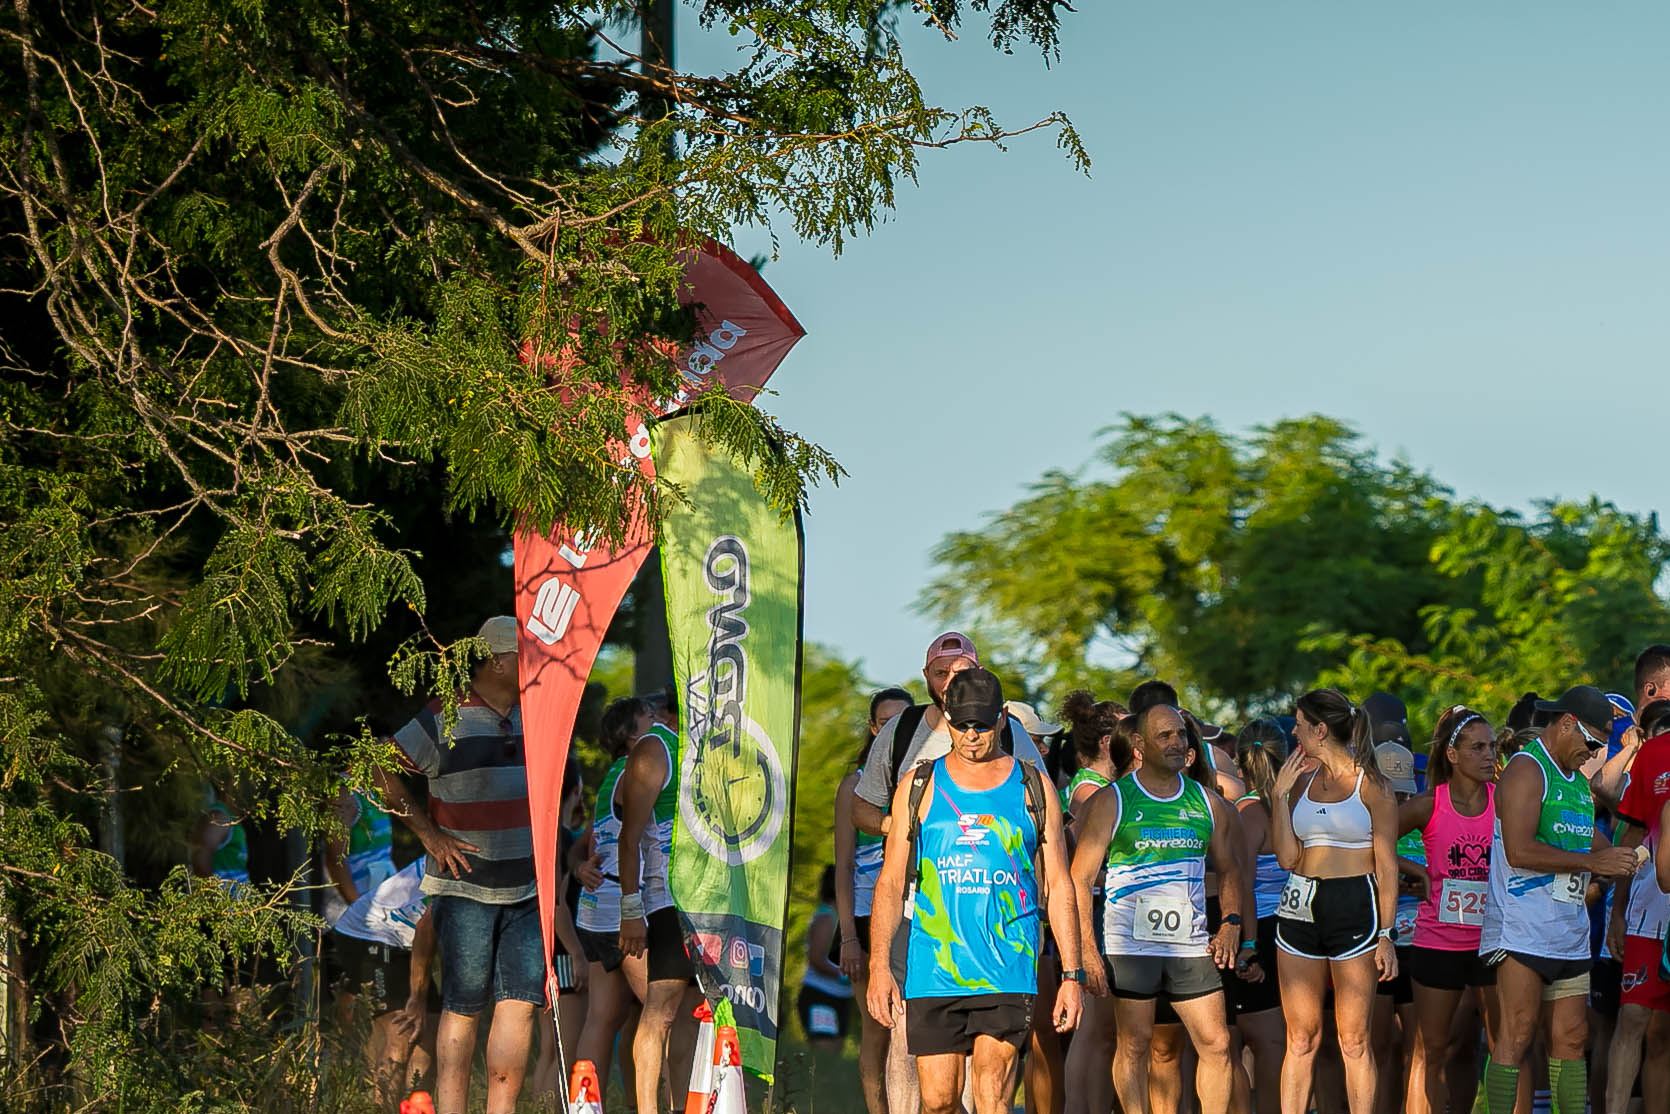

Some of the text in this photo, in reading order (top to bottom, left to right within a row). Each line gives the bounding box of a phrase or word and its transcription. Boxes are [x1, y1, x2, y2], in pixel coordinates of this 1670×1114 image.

[936, 853, 974, 869] HALF
[938, 867, 1018, 887] TRIATLON
[955, 886, 991, 896] ROSARIO
[1147, 908, 1182, 932] 90
